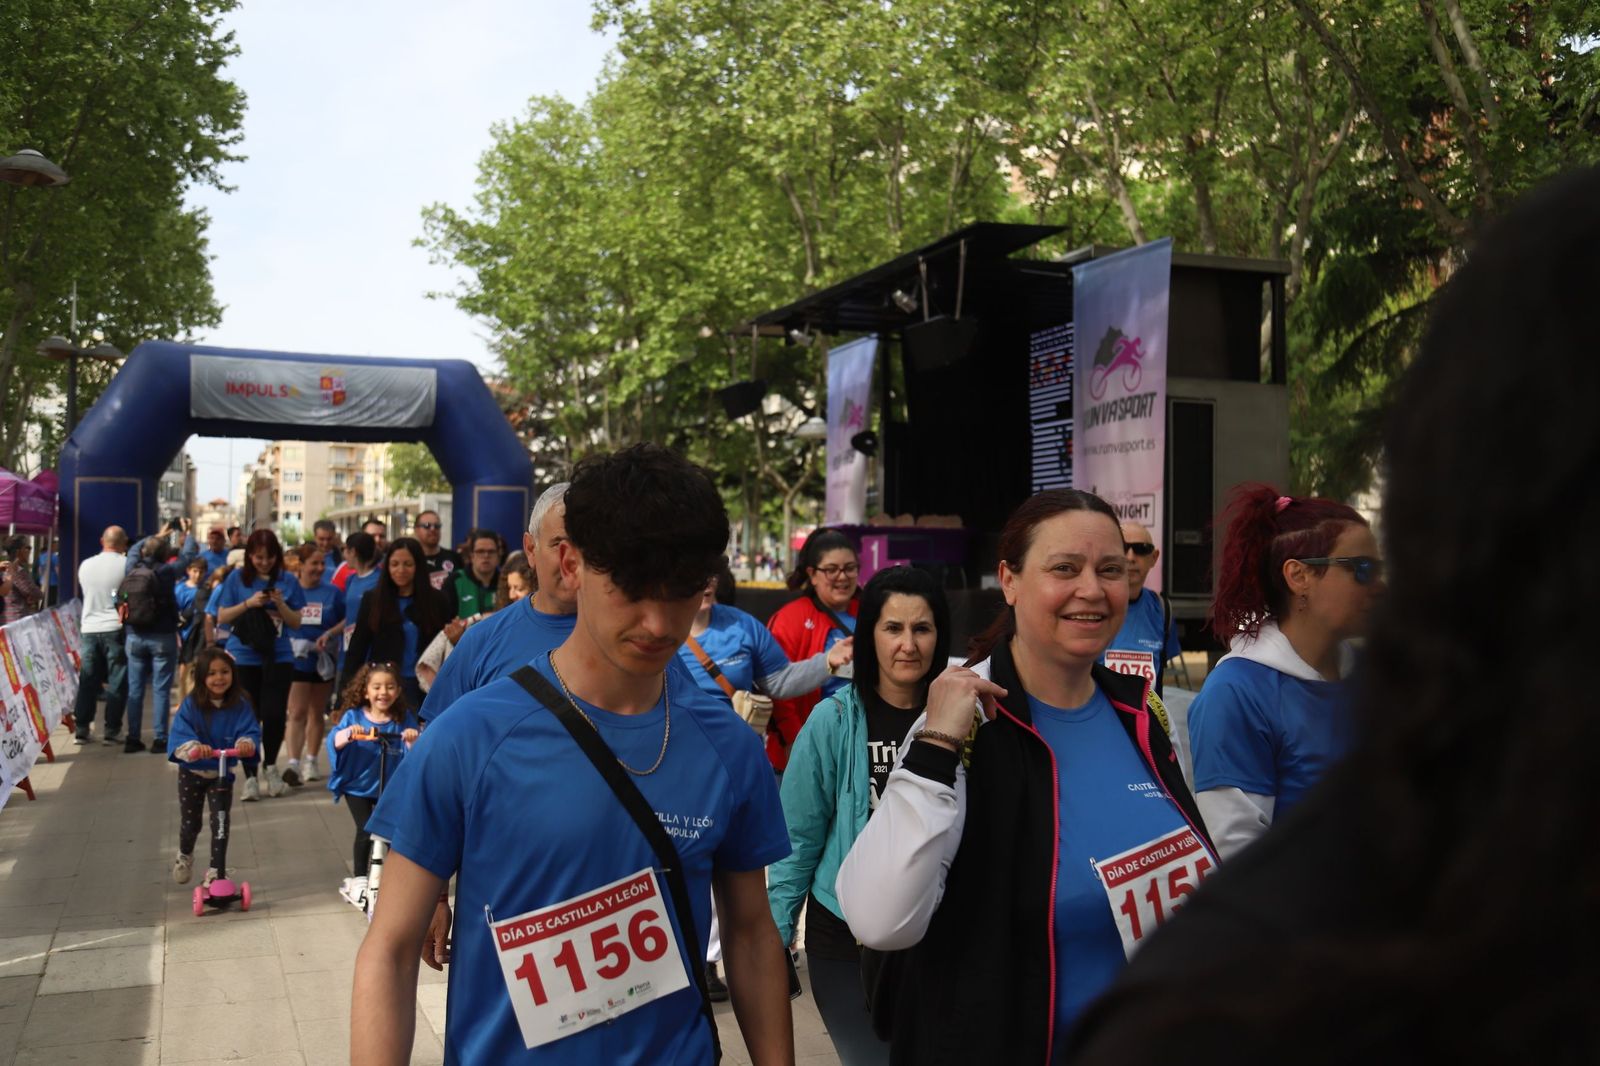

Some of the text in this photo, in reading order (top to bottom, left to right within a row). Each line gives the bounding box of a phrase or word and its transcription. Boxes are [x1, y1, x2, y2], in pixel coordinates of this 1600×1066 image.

[225, 381, 302, 400] IMPULSA
[870, 540, 879, 571] 1
[867, 741, 903, 763] Tri
[874, 765, 888, 773] 2021
[683, 815, 690, 827] Y
[1107, 865, 1125, 881] DÍA
[1126, 860, 1140, 871] DE
[1140, 844, 1176, 865] CASTILLA
[1178, 842, 1185, 851] Y
[501, 881, 649, 944] DÍA DE CASTILLA Y LEÓN
[514, 909, 669, 1007] 1156
